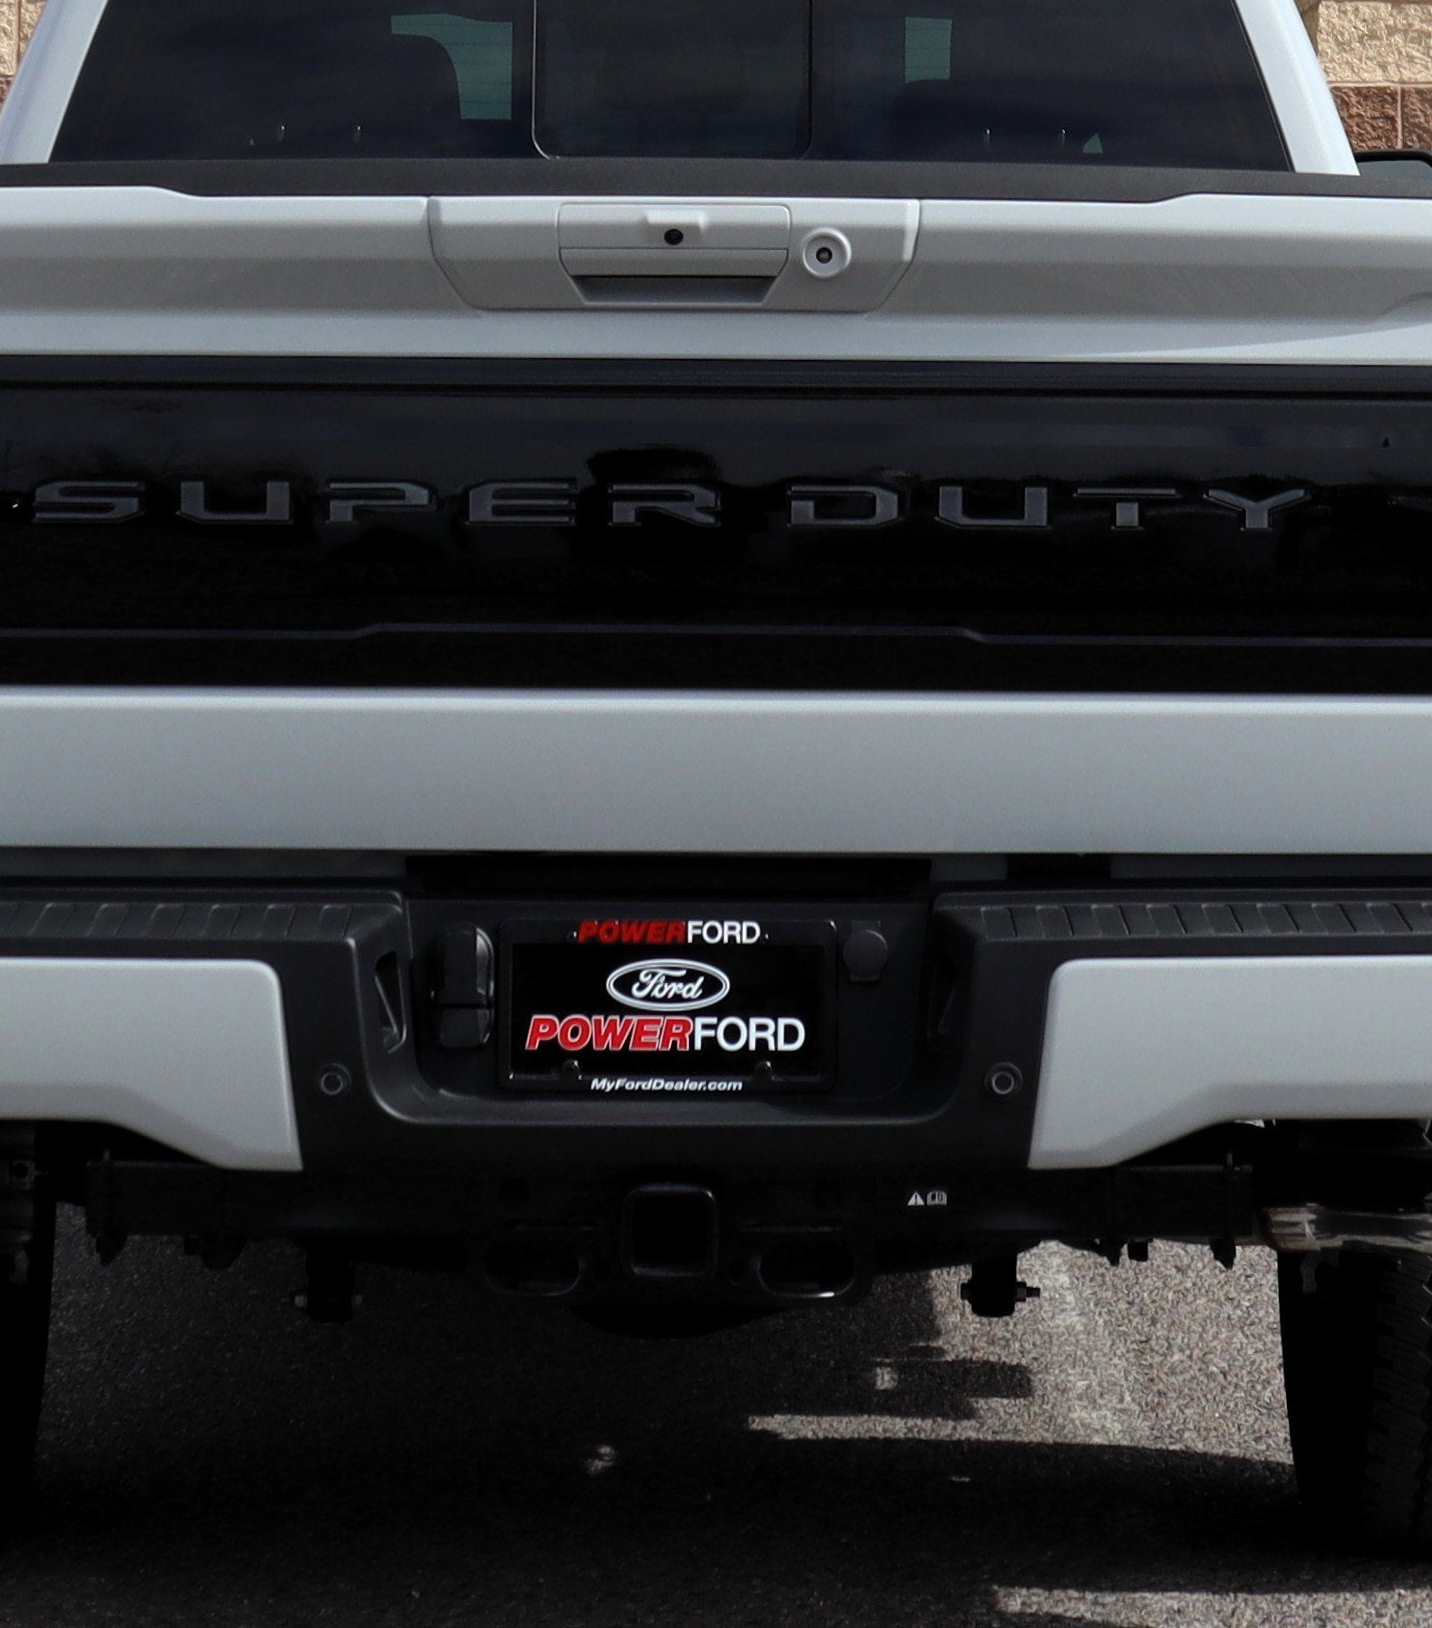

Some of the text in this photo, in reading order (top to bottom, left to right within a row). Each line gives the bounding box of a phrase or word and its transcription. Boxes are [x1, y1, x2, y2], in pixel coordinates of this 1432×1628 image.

[32, 478, 1312, 530] SUPER DUTY
[578, 921, 760, 945] POWERFORD
[631, 969, 704, 1000] Ford
[526, 1015, 806, 1052] POWERFORD
[590, 1078, 743, 1092] MyFordDealer.com
